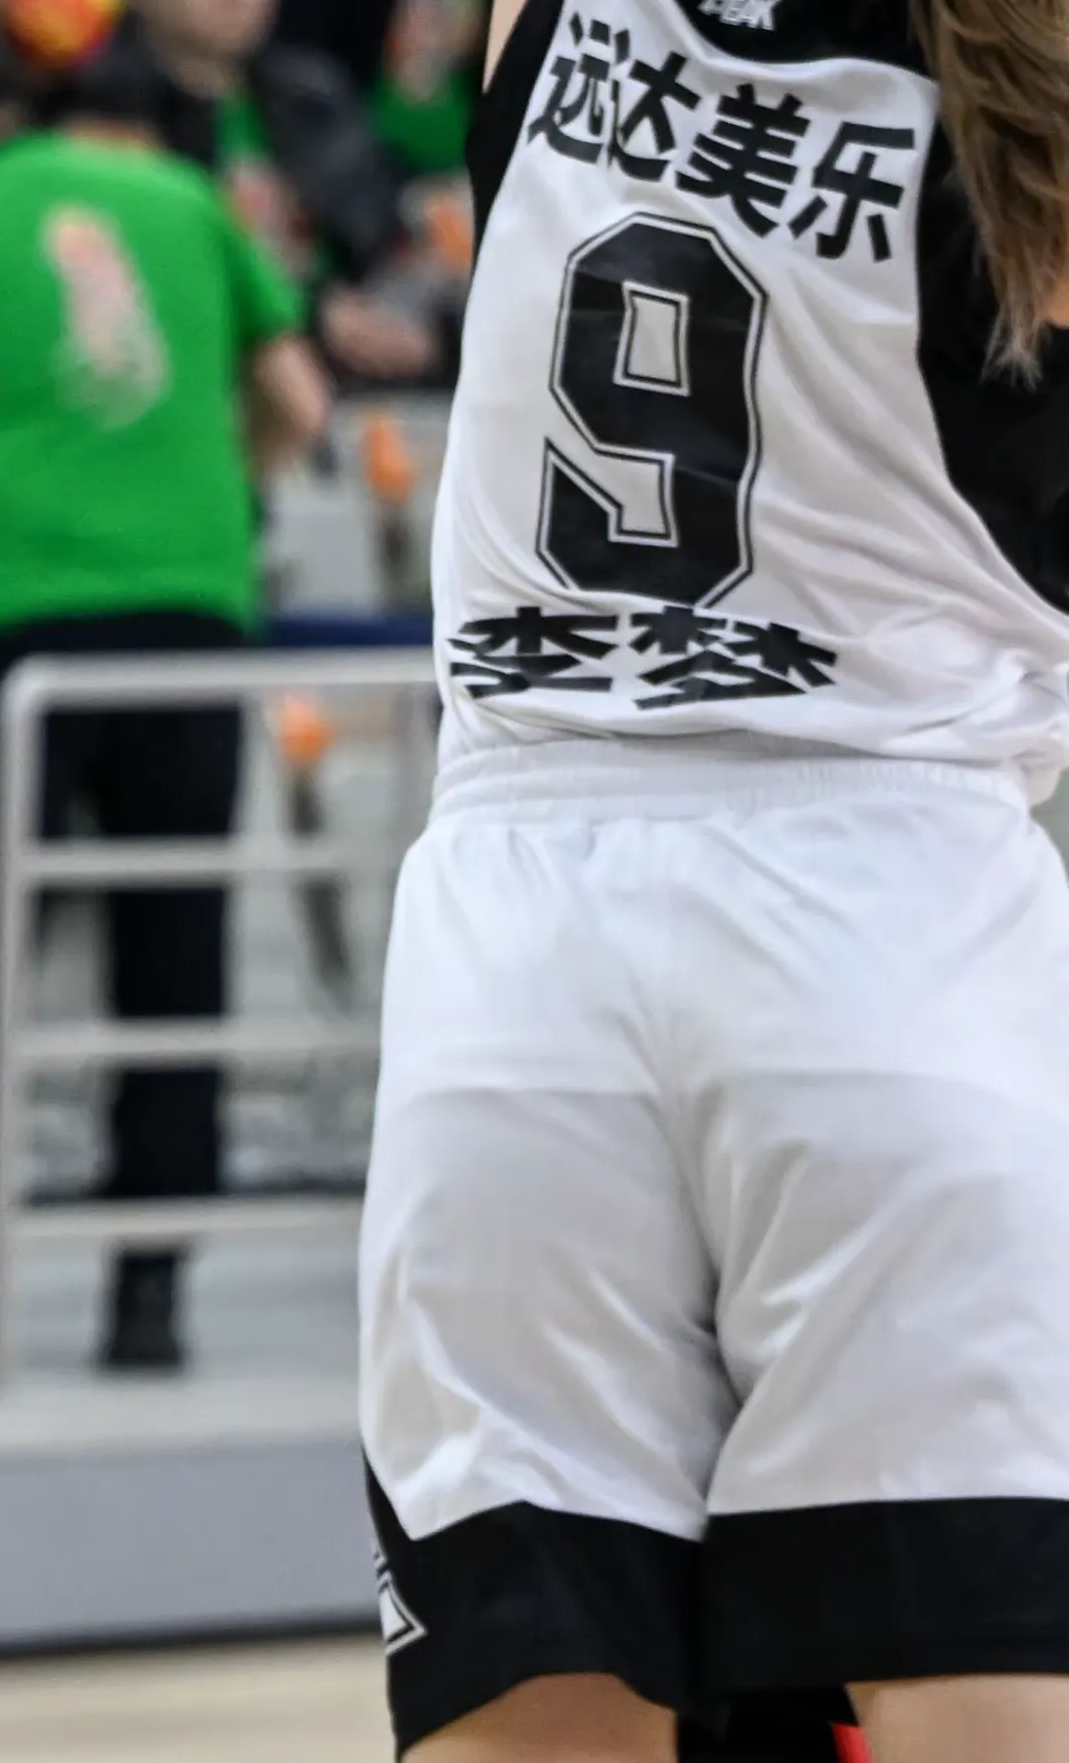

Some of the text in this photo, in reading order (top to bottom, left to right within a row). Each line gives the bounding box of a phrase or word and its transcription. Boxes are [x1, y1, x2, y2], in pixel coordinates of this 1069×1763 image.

[529, 10, 915, 262] 远达美乐
[534, 211, 769, 609] 9
[450, 604, 838, 710] 李梦
